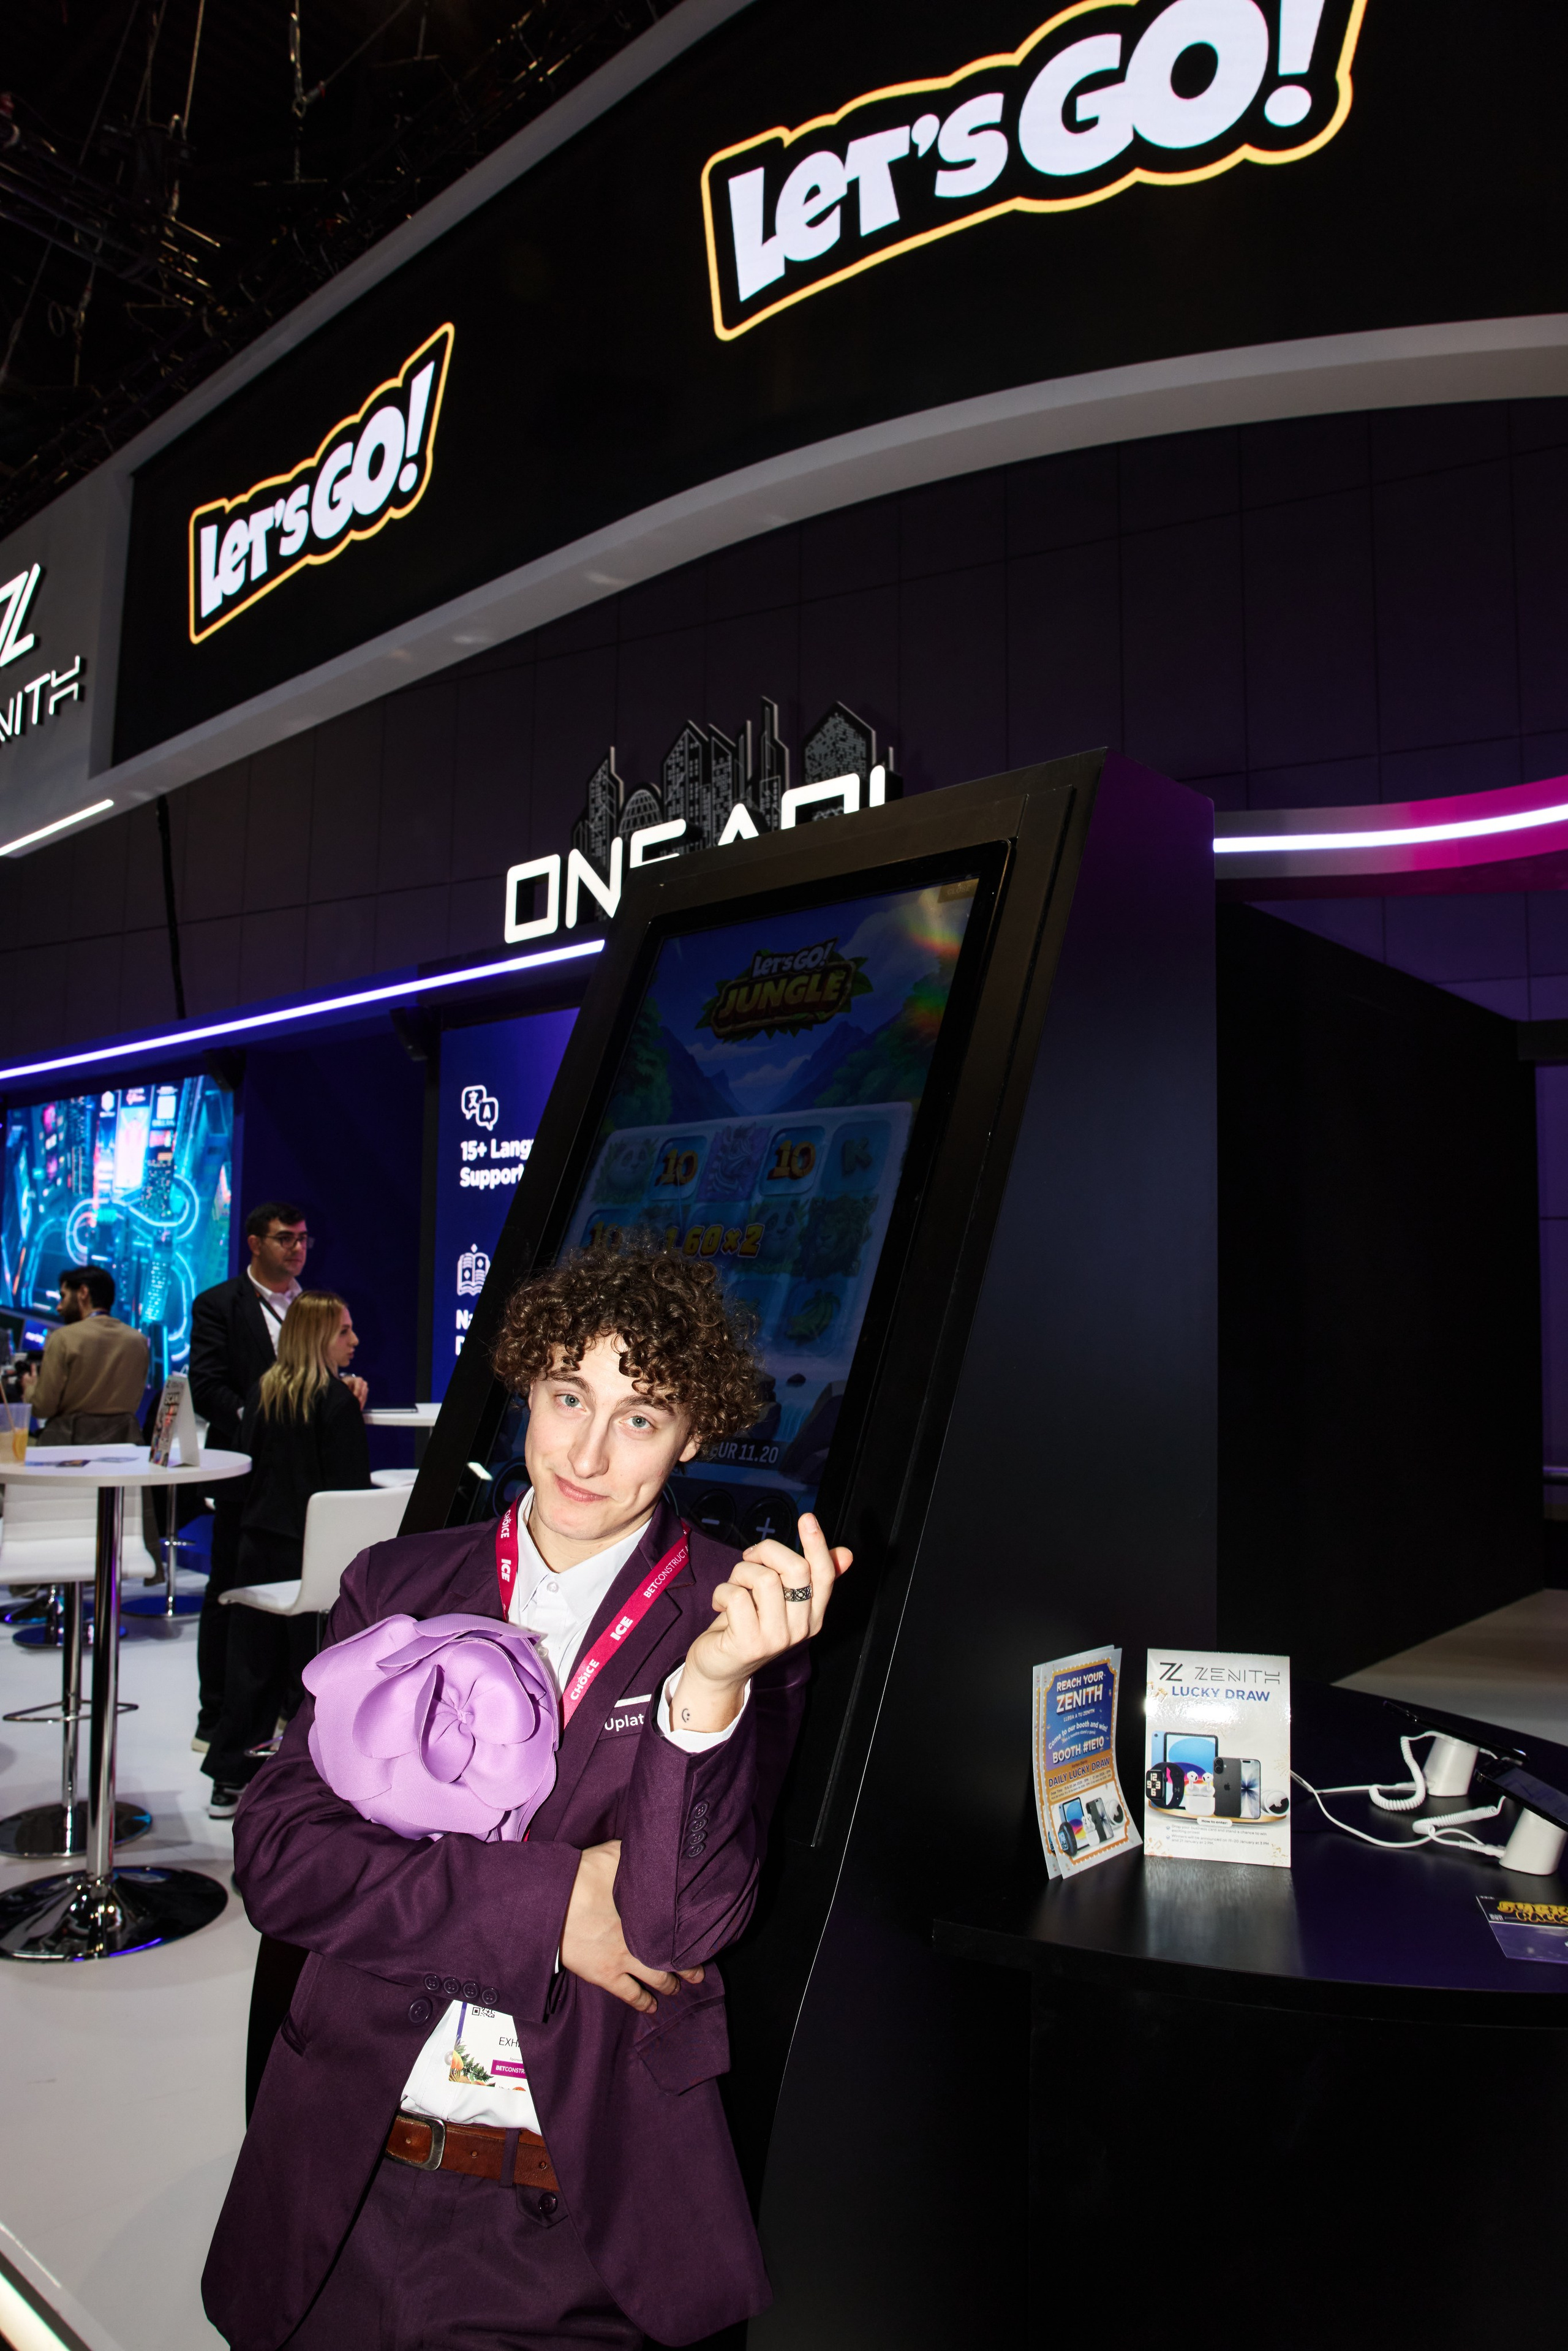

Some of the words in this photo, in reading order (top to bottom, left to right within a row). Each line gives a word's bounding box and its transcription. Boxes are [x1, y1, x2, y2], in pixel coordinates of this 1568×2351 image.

[1018, 0, 1325, 176] GO!
[311, 361, 435, 535] GO!
[792, 940, 836, 972] GO!
[718, 969, 848, 1019] JUNGLE
[461, 1140, 488, 1161] 15+
[491, 1138, 535, 1160] Lang
[655, 1147, 699, 1186] 10
[767, 1139, 816, 1181] 10
[737, 1443, 779, 1464] 11.20
[500, 1509, 511, 1539] CHOICE
[501, 1558, 511, 1582] ICE
[643, 1548, 687, 1599] BETCONSTRUCT
[610, 1615, 634, 1641] ICE
[570, 1658, 600, 1700] CHOICE
[1057, 1677, 1081, 1692] REACH
[1083, 1670, 1104, 1685] YOUR
[1194, 1667, 1280, 1685] ZENITH
[1056, 1683, 1103, 1714] ZENITH
[1172, 1686, 1220, 1698] LUCKY
[1225, 1689, 1270, 1702] DRAW
[1083, 1708, 1095, 1716] ZENITH
[1076, 1720, 1090, 1729] booth
[1099, 1723, 1108, 1732] win!
[1052, 1743, 1081, 1764] BOOTH
[1083, 1735, 1104, 1753] #1E10
[1049, 1773, 1068, 1787] DAILY
[1069, 1764, 1090, 1780] LUCKY
[1091, 1757, 1110, 1772] DRAW
[499, 2036, 520, 2048] EXH
[496, 2065, 526, 2075] BETCONSTR
